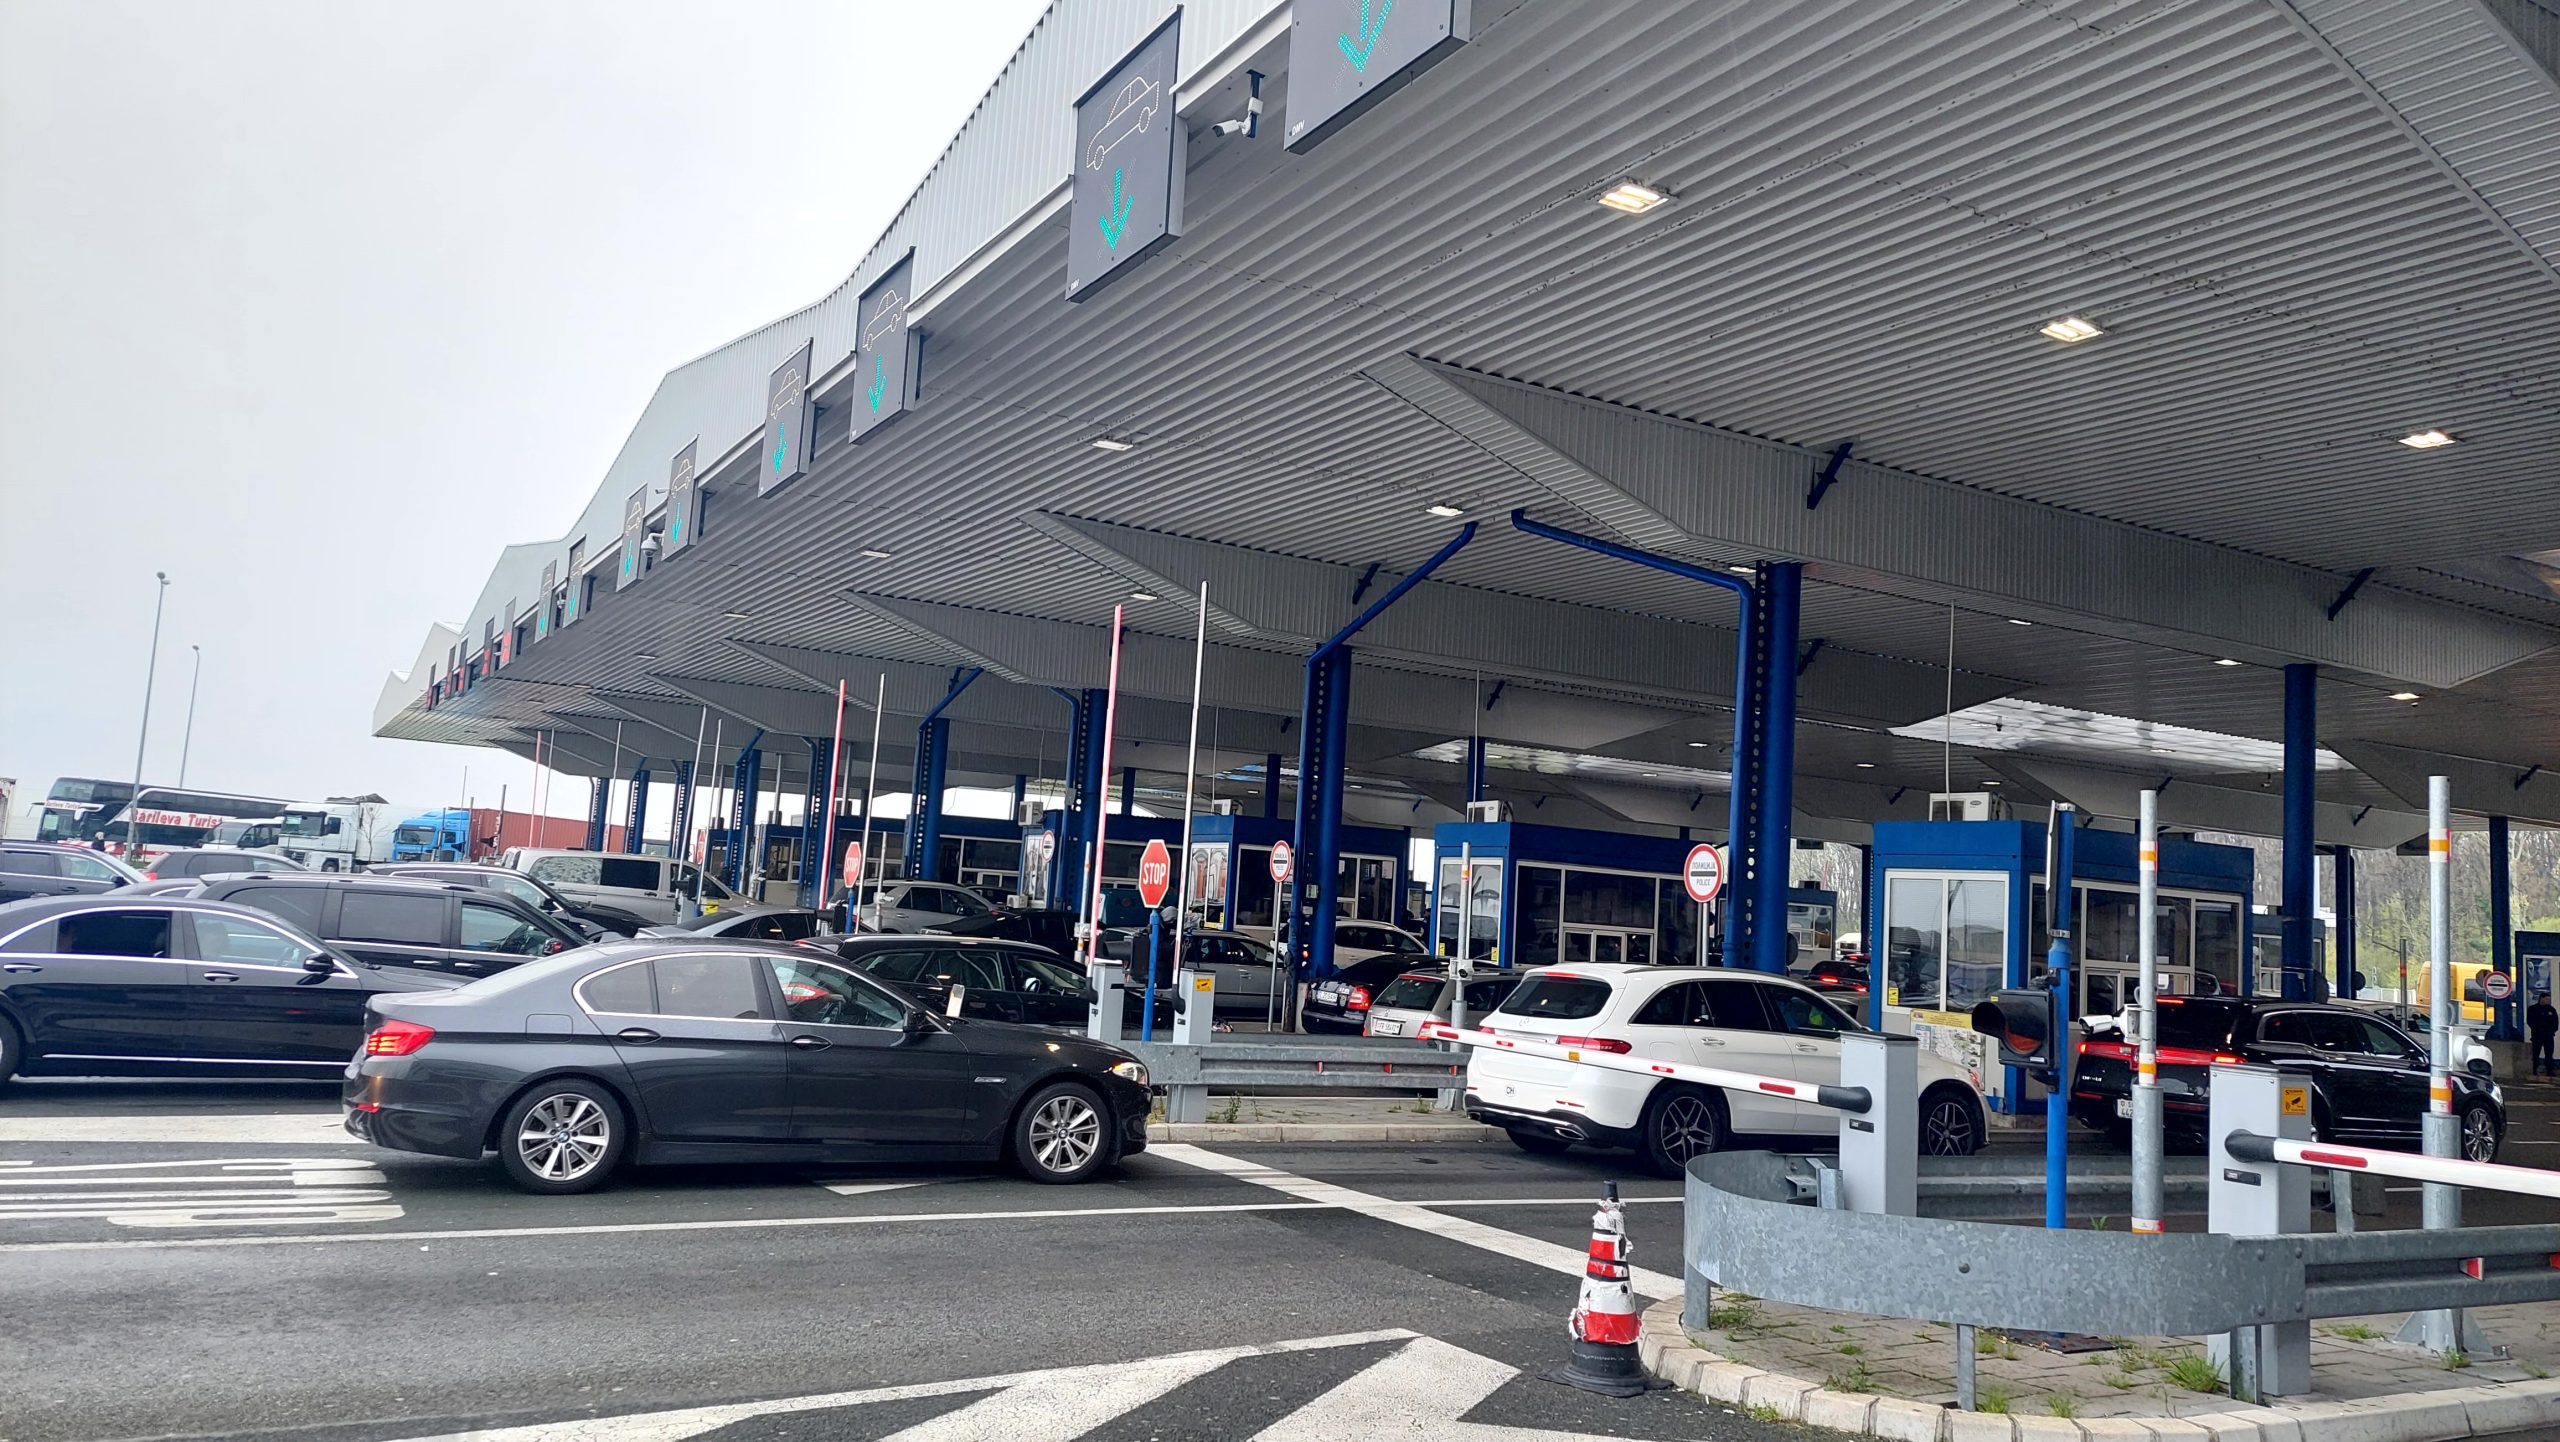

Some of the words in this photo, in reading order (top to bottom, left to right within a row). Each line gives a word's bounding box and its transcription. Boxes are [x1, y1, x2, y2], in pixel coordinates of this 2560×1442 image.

[1292, 120, 1305, 136] DMV
[845, 856, 859, 873] STOP
[1143, 862, 1167, 886] STOP
[1696, 878, 1711, 886] POLICE
